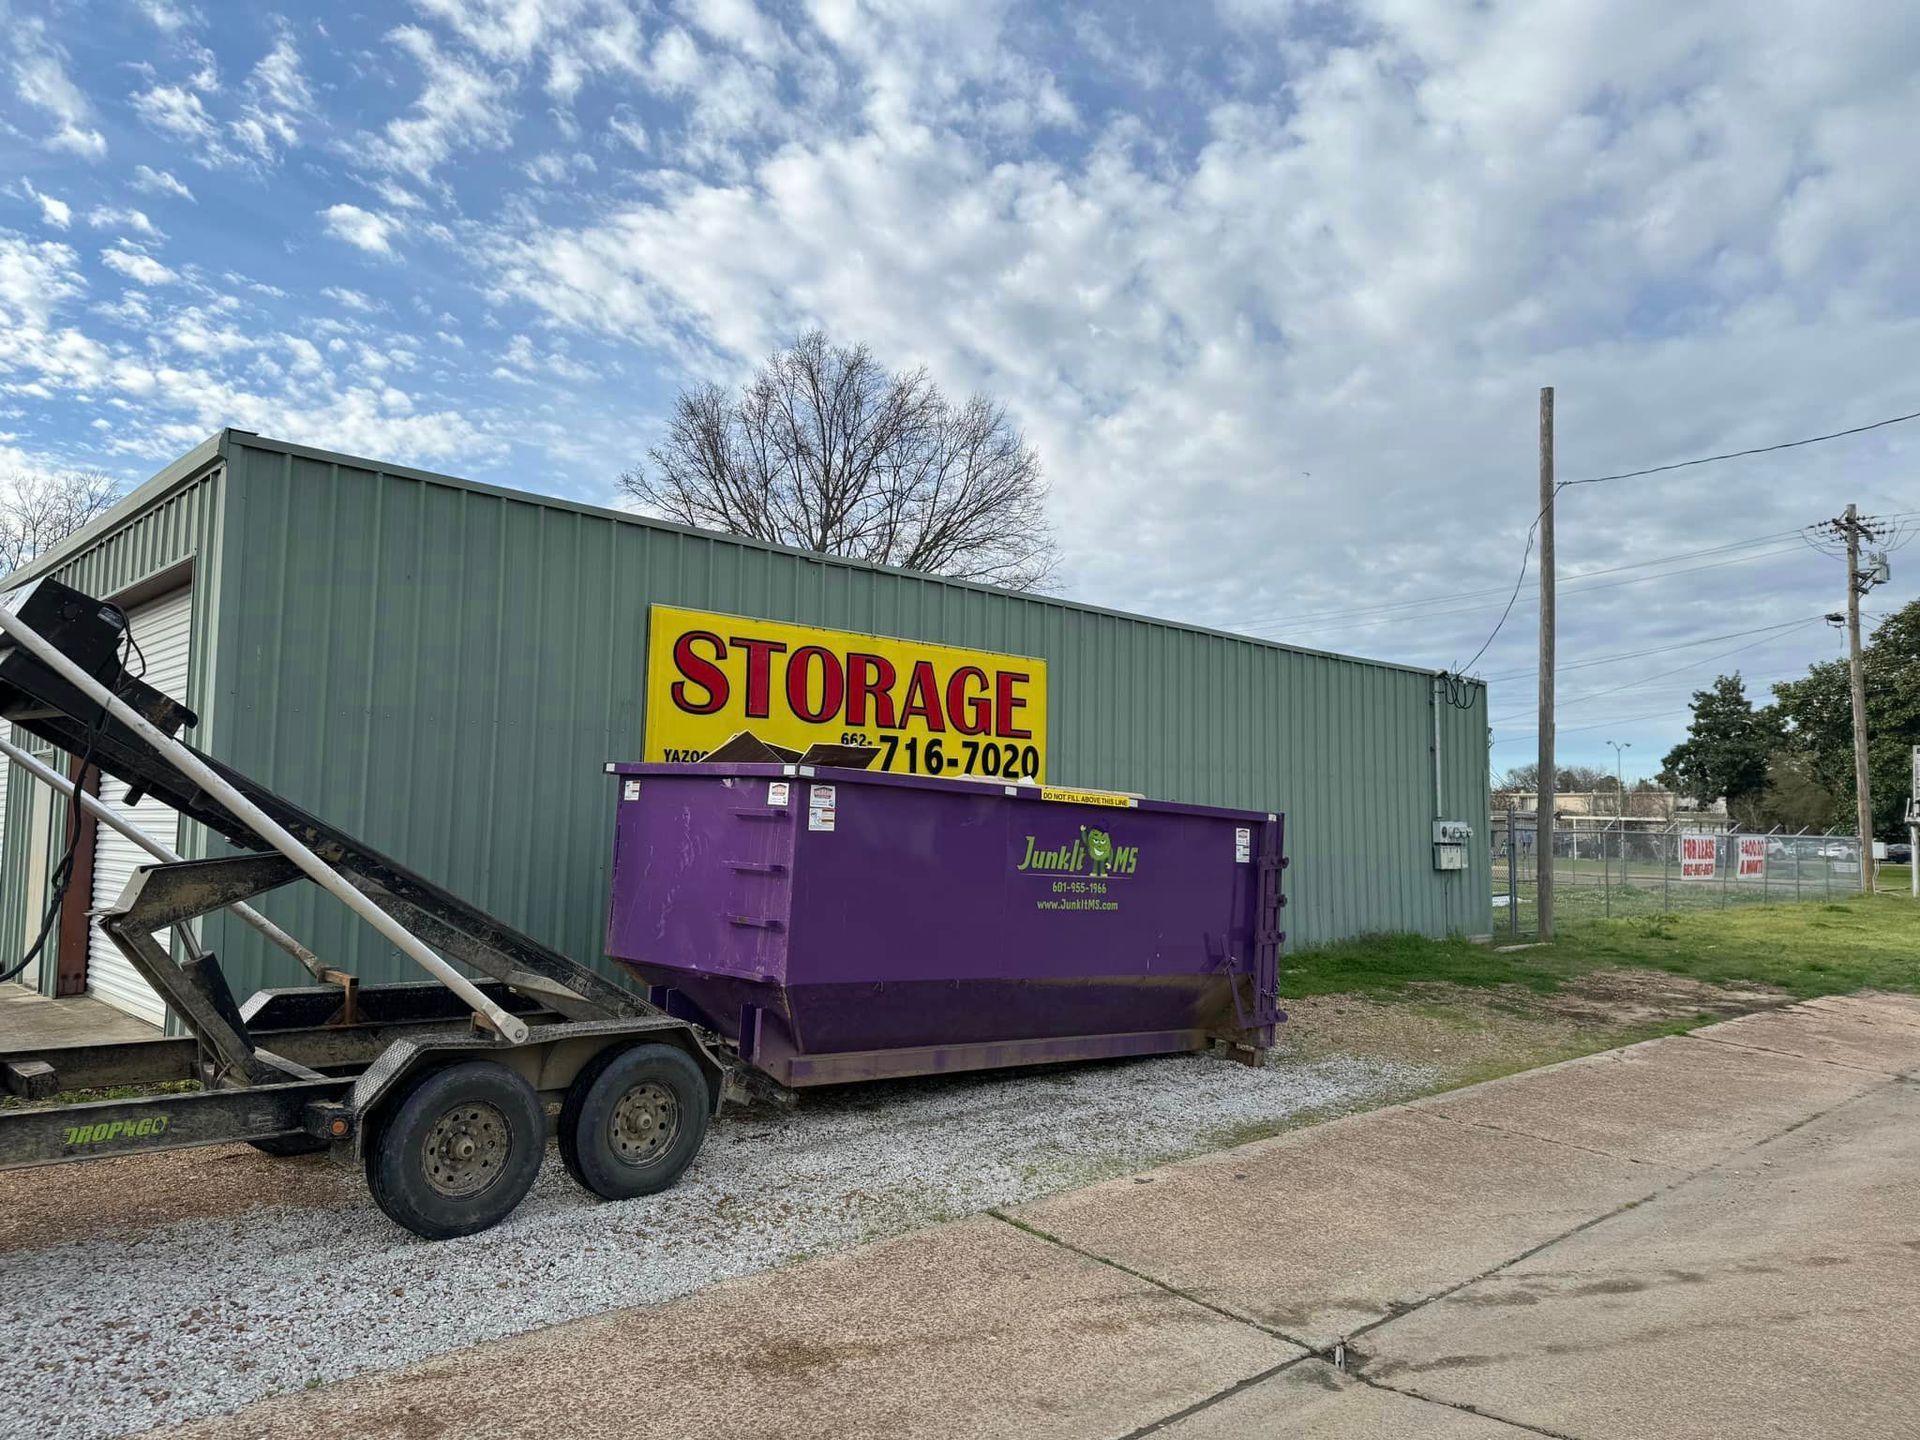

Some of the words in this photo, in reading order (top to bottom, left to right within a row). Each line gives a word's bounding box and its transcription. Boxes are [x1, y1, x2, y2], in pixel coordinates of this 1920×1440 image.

[671, 630, 1032, 740] STORAGE
[879, 735, 1039, 779] 716-7020
[1067, 794, 1079, 802] FILL
[1082, 795, 1100, 804] ABOVE
[1101, 797, 1114, 805] THIS
[1017, 835, 1086, 872] JunkIt
[1112, 846, 1139, 874] MS
[1683, 839, 1697, 860] FOR
[1052, 881, 1107, 894] 601-955-1966
[1036, 898, 1119, 911] www.JunkItMS.com
